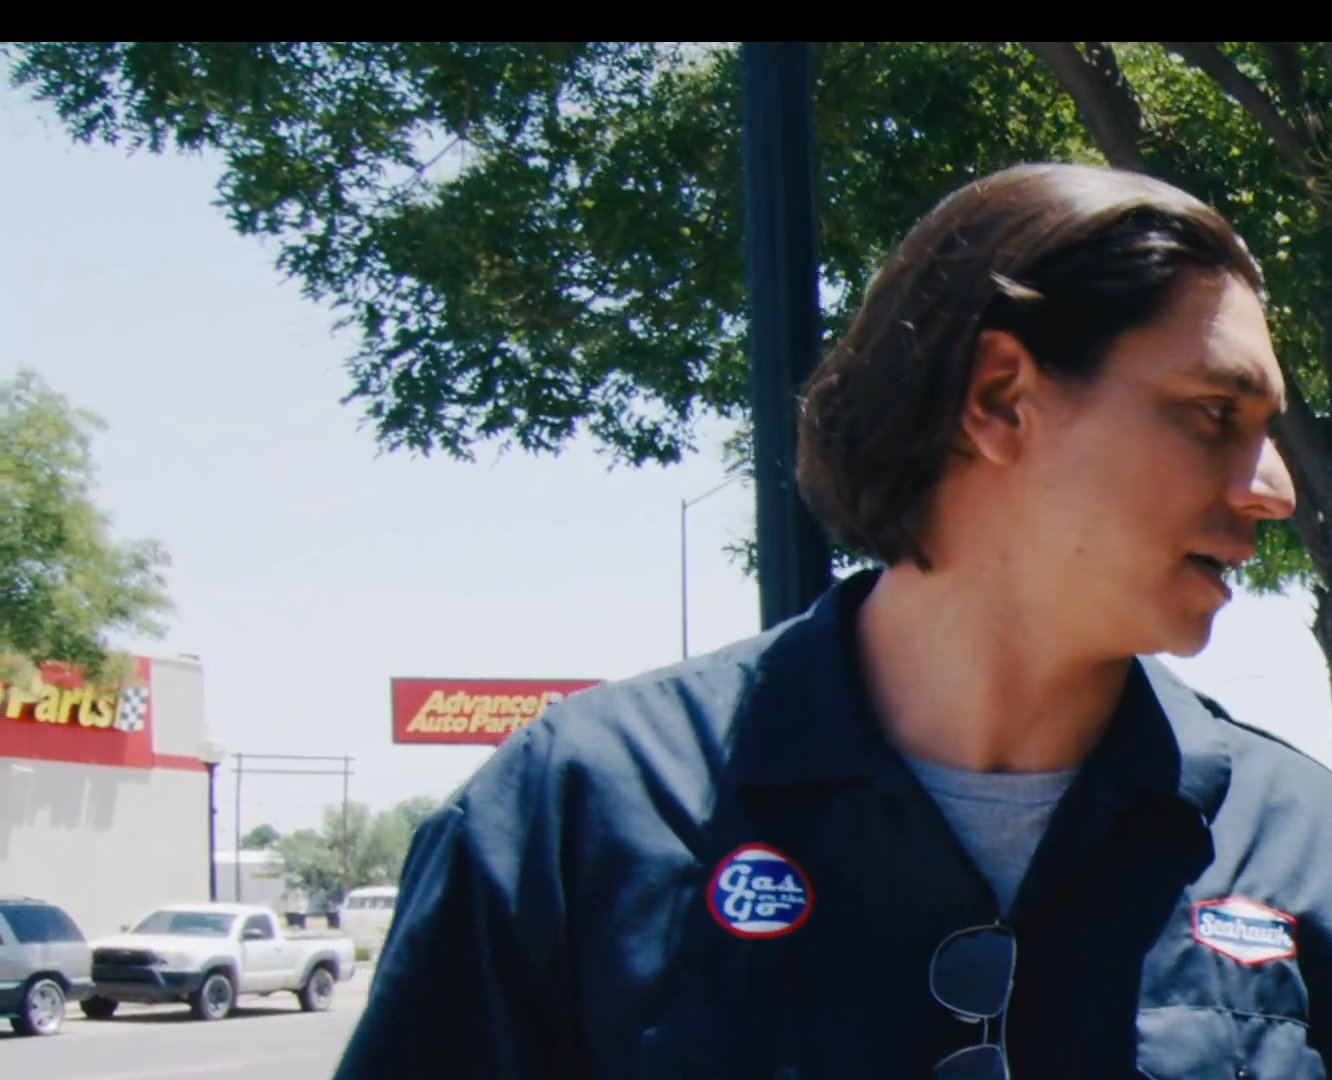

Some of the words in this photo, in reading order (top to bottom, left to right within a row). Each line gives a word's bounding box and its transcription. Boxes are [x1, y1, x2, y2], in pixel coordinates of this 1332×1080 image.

[423, 690, 538, 714] Advance
[406, 711, 468, 733] Auto
[718, 863, 804, 894] Gas
[722, 888, 792, 922] Go
